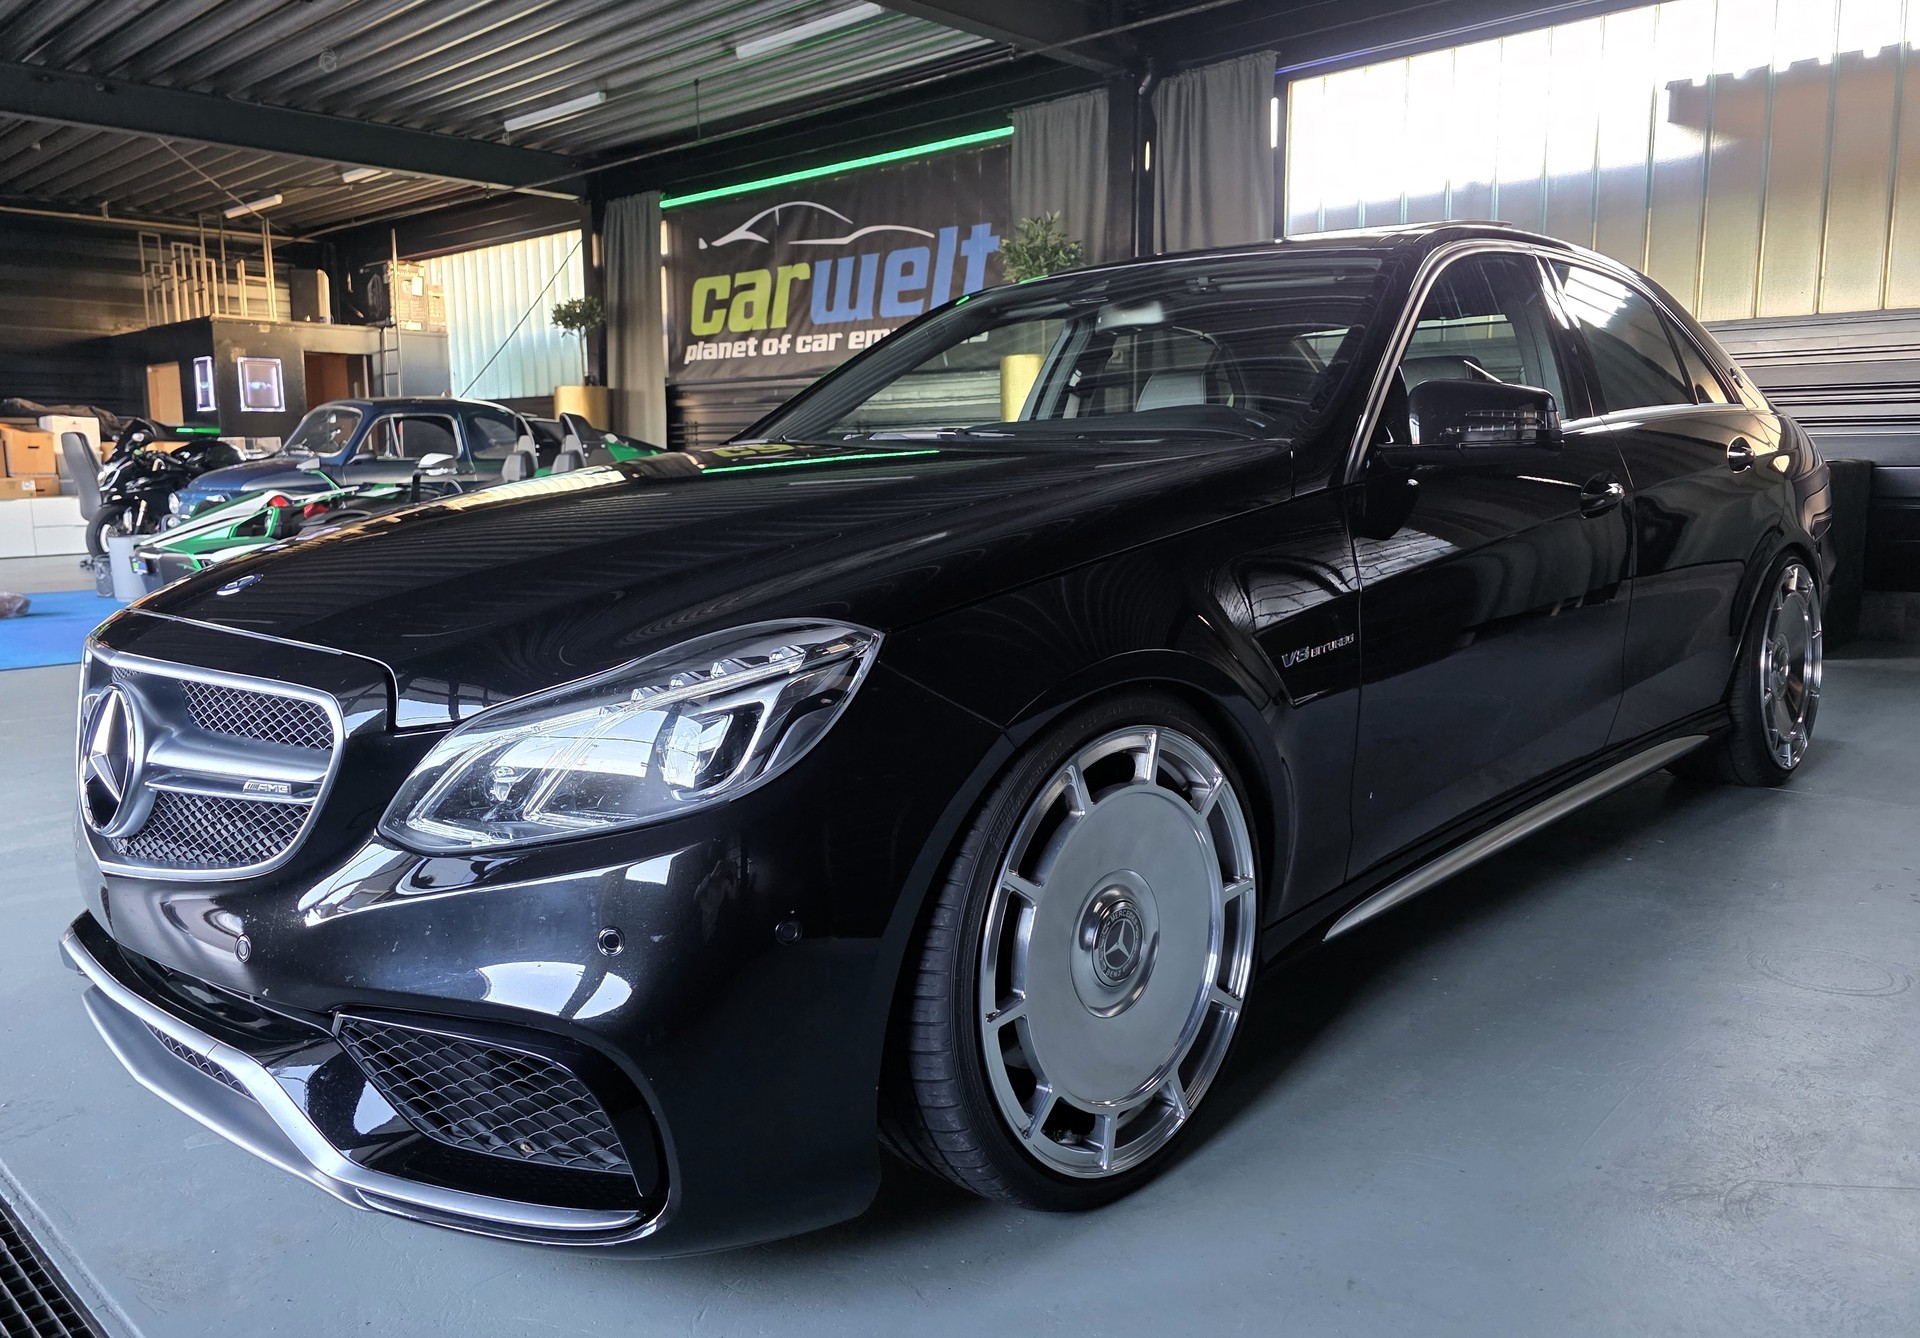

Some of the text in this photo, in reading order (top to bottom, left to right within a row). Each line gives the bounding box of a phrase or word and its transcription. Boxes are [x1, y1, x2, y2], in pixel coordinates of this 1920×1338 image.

[690, 223, 1000, 336] carwelt
[684, 336, 758, 364] planet
[762, 334, 792, 355] of
[796, 332, 842, 353] car
[1281, 633, 1354, 668] V8 BITURBO
[257, 783, 288, 793] AMG
